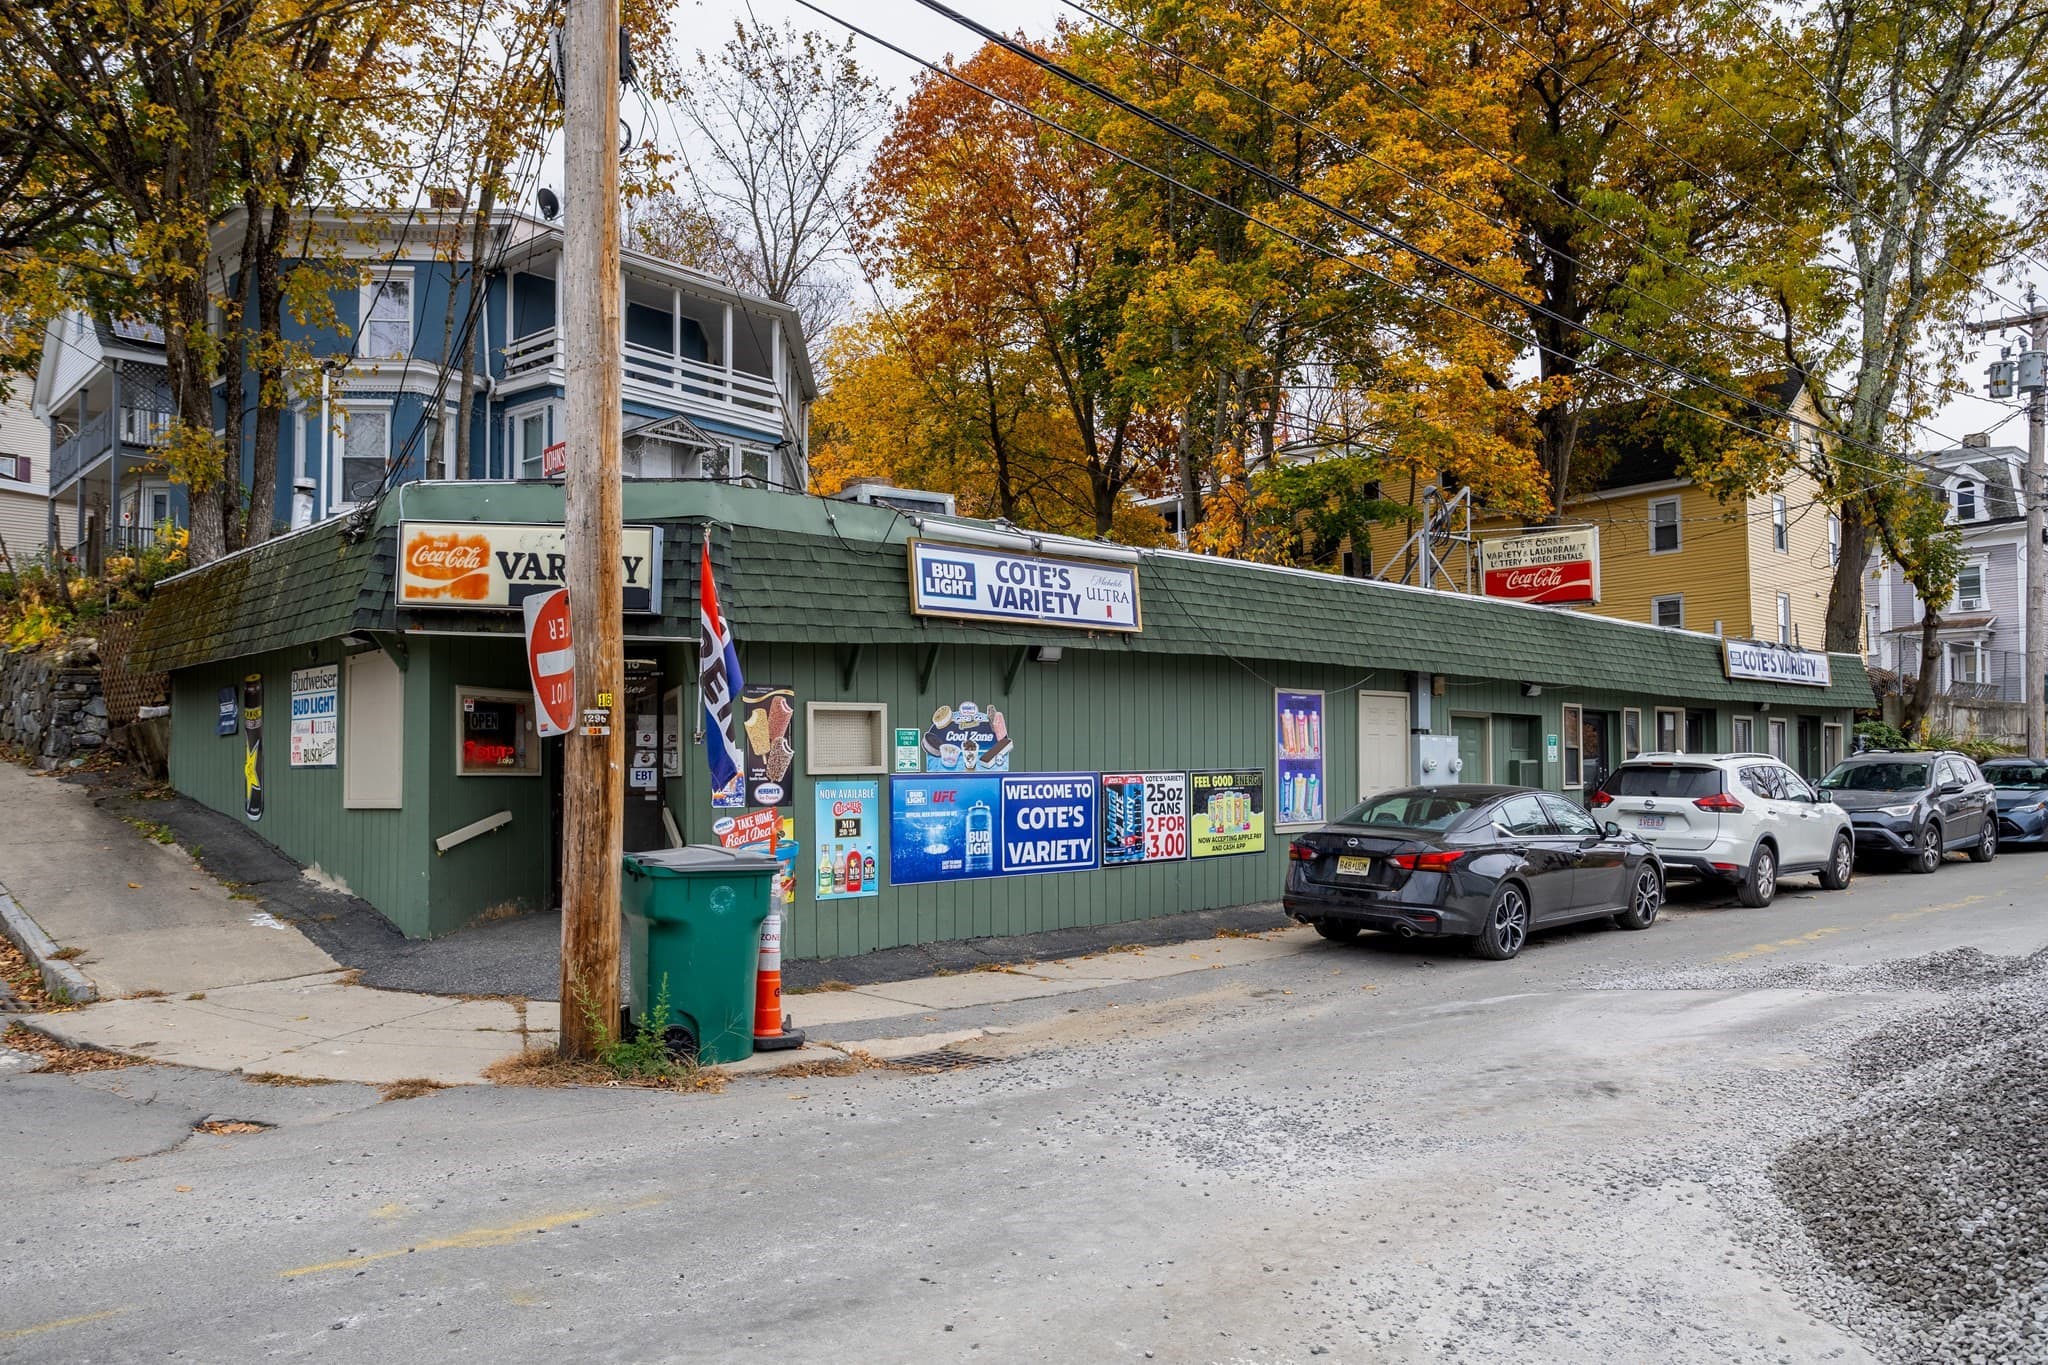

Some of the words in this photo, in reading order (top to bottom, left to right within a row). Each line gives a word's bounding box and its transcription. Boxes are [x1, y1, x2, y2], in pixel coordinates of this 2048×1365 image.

[412, 545, 483, 569] Coca-Cola
[1486, 549, 1522, 560] VARIETY
[1530, 555, 1552, 564] VIDEO
[1553, 552, 1584, 563] RENTALS
[495, 551, 644, 584] VARY
[931, 561, 967, 580] BUD
[995, 560, 1072, 591] COTE'S
[1506, 566, 1564, 590] Coca-Cola
[925, 578, 974, 596] LIGHT
[1085, 587, 1130, 604] ULTRA
[987, 584, 1081, 616] VARIETY
[1742, 650, 1777, 673] COTE'S
[1776, 653, 1816, 677] VARIETY
[292, 669, 337, 693] Budweiser
[293, 698, 310, 716] BUD
[310, 696, 335, 713] LIGHT
[315, 720, 337, 735] ULTRA
[471, 713, 497, 729] OPEN
[946, 730, 968, 741] Cool
[968, 731, 994, 741] Zone
[303, 748, 322, 764] BUSCH
[635, 770, 653, 782] EBT
[1194, 775, 1211, 788] FEEL
[1212, 775, 1233, 787] GOOD
[820, 789, 837, 800] NOW
[838, 788, 875, 799] AVAILABLE
[932, 790, 958, 803] UFC
[1006, 784, 1073, 800] WELCOME
[1074, 783, 1092, 798] TO
[1106, 787, 1117, 845] Natural
[1127, 796, 1135, 833] Natty
[1151, 803, 1181, 815] CANS
[736, 817, 755, 831] TAKE
[754, 811, 775, 827] HOME
[841, 820, 855, 829] MD
[1017, 806, 1085, 830] COTE'S
[1146, 817, 1155, 832] 2
[1158, 816, 1185, 832] FOR
[725, 829, 749, 848] Real
[969, 830, 990, 843] BUD
[1212, 834, 1237, 842] ACCEPTING
[1238, 833, 1253, 841] APPLE
[1008, 838, 1092, 865] VARIETY
[1146, 833, 1185, 859] $3.00
